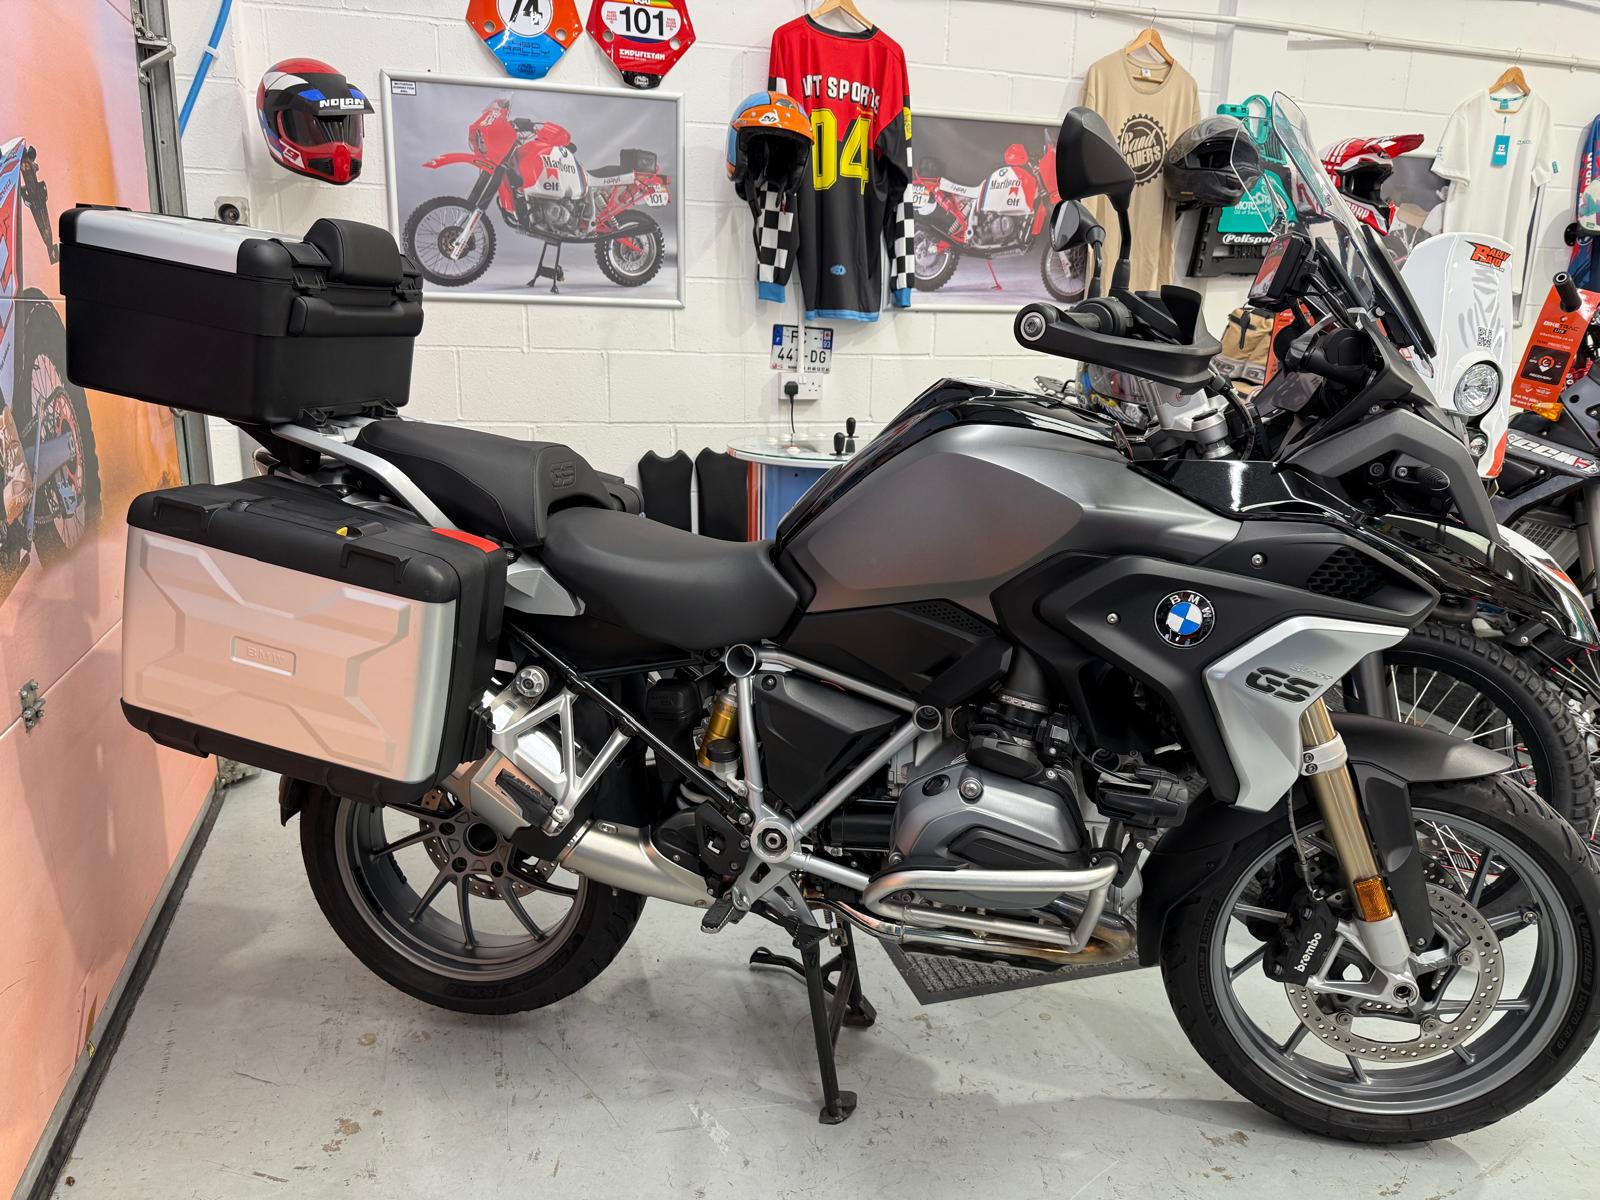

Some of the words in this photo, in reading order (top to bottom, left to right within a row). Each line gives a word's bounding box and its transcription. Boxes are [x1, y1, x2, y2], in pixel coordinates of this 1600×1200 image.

[619, 6, 664, 36] 101
[319, 97, 365, 109] NOLAN
[827, 76, 881, 114] SPORTS
[810, 108, 872, 195] 04
[1123, 127, 1158, 156] Sand
[543, 156, 576, 175] Marlboro
[1126, 145, 1162, 169] AIDERS
[543, 181, 560, 191] elf
[991, 179, 1021, 190] Marlboro
[650, 194, 663, 204] 101
[912, 195, 922, 204] 01
[1006, 198, 1020, 207] elf
[1223, 233, 1277, 245] Polispor
[1511, 438, 1579, 466] CCM
[1169, 593, 1212, 618] BMW
[247, 645, 287, 665] BMW
[1245, 666, 1320, 703] GS
[1293, 932, 1322, 973] brembo
[1580, 926, 1594, 985] MICHELIN
